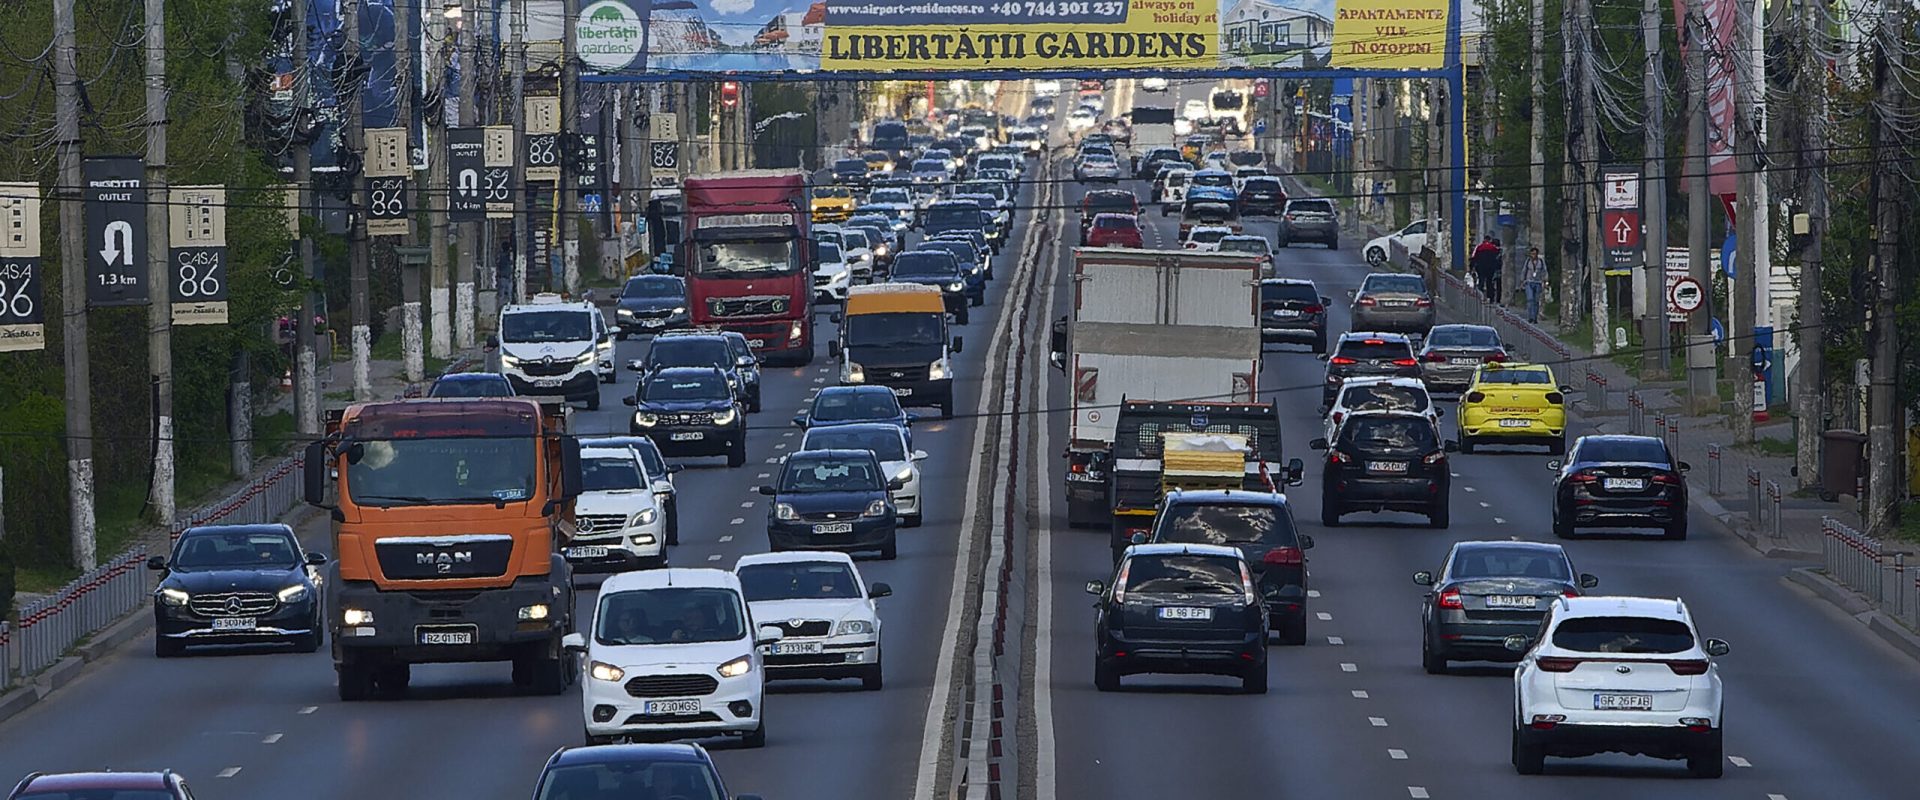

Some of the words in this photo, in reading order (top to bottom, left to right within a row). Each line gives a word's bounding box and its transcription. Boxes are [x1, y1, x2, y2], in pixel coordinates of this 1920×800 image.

[828, 3, 985, 18] www.airport-residences.ro
[991, 2, 1021, 17] +40
[1026, 1, 1055, 17] 744
[1059, 1, 1090, 16] 301
[1093, 1, 1124, 16] 237
[1132, 0, 1176, 11] always
[1179, 0, 1195, 10] on
[1153, 12, 1201, 25] holiday
[1204, 13, 1218, 23] at
[1340, 8, 1445, 20] APARTAMENTE
[1375, 26, 1407, 36] VILE
[582, 41, 634, 58] gardens
[828, 27, 1027, 64] LIBERTĂȚII
[1034, 32, 1206, 58] GARDENS
[1370, 42, 1432, 54] OTOPENI
[530, 141, 555, 164] 86
[653, 149, 675, 166] 86
[99, 193, 132, 201] OUTLET
[371, 190, 403, 215] 86
[178, 251, 219, 265] CASA
[98, 274, 118, 285] 1.3
[120, 273, 137, 285] km
[179, 263, 219, 297] 86
[416, 551, 472, 566] MAN
[1491, 596, 1498, 605] B
[1166, 608, 1173, 618] B
[650, 702, 658, 712] B
[661, 701, 698, 712] 230HGS
[1600, 695, 1615, 706] GR
[1618, 695, 1650, 706] 26FAB
